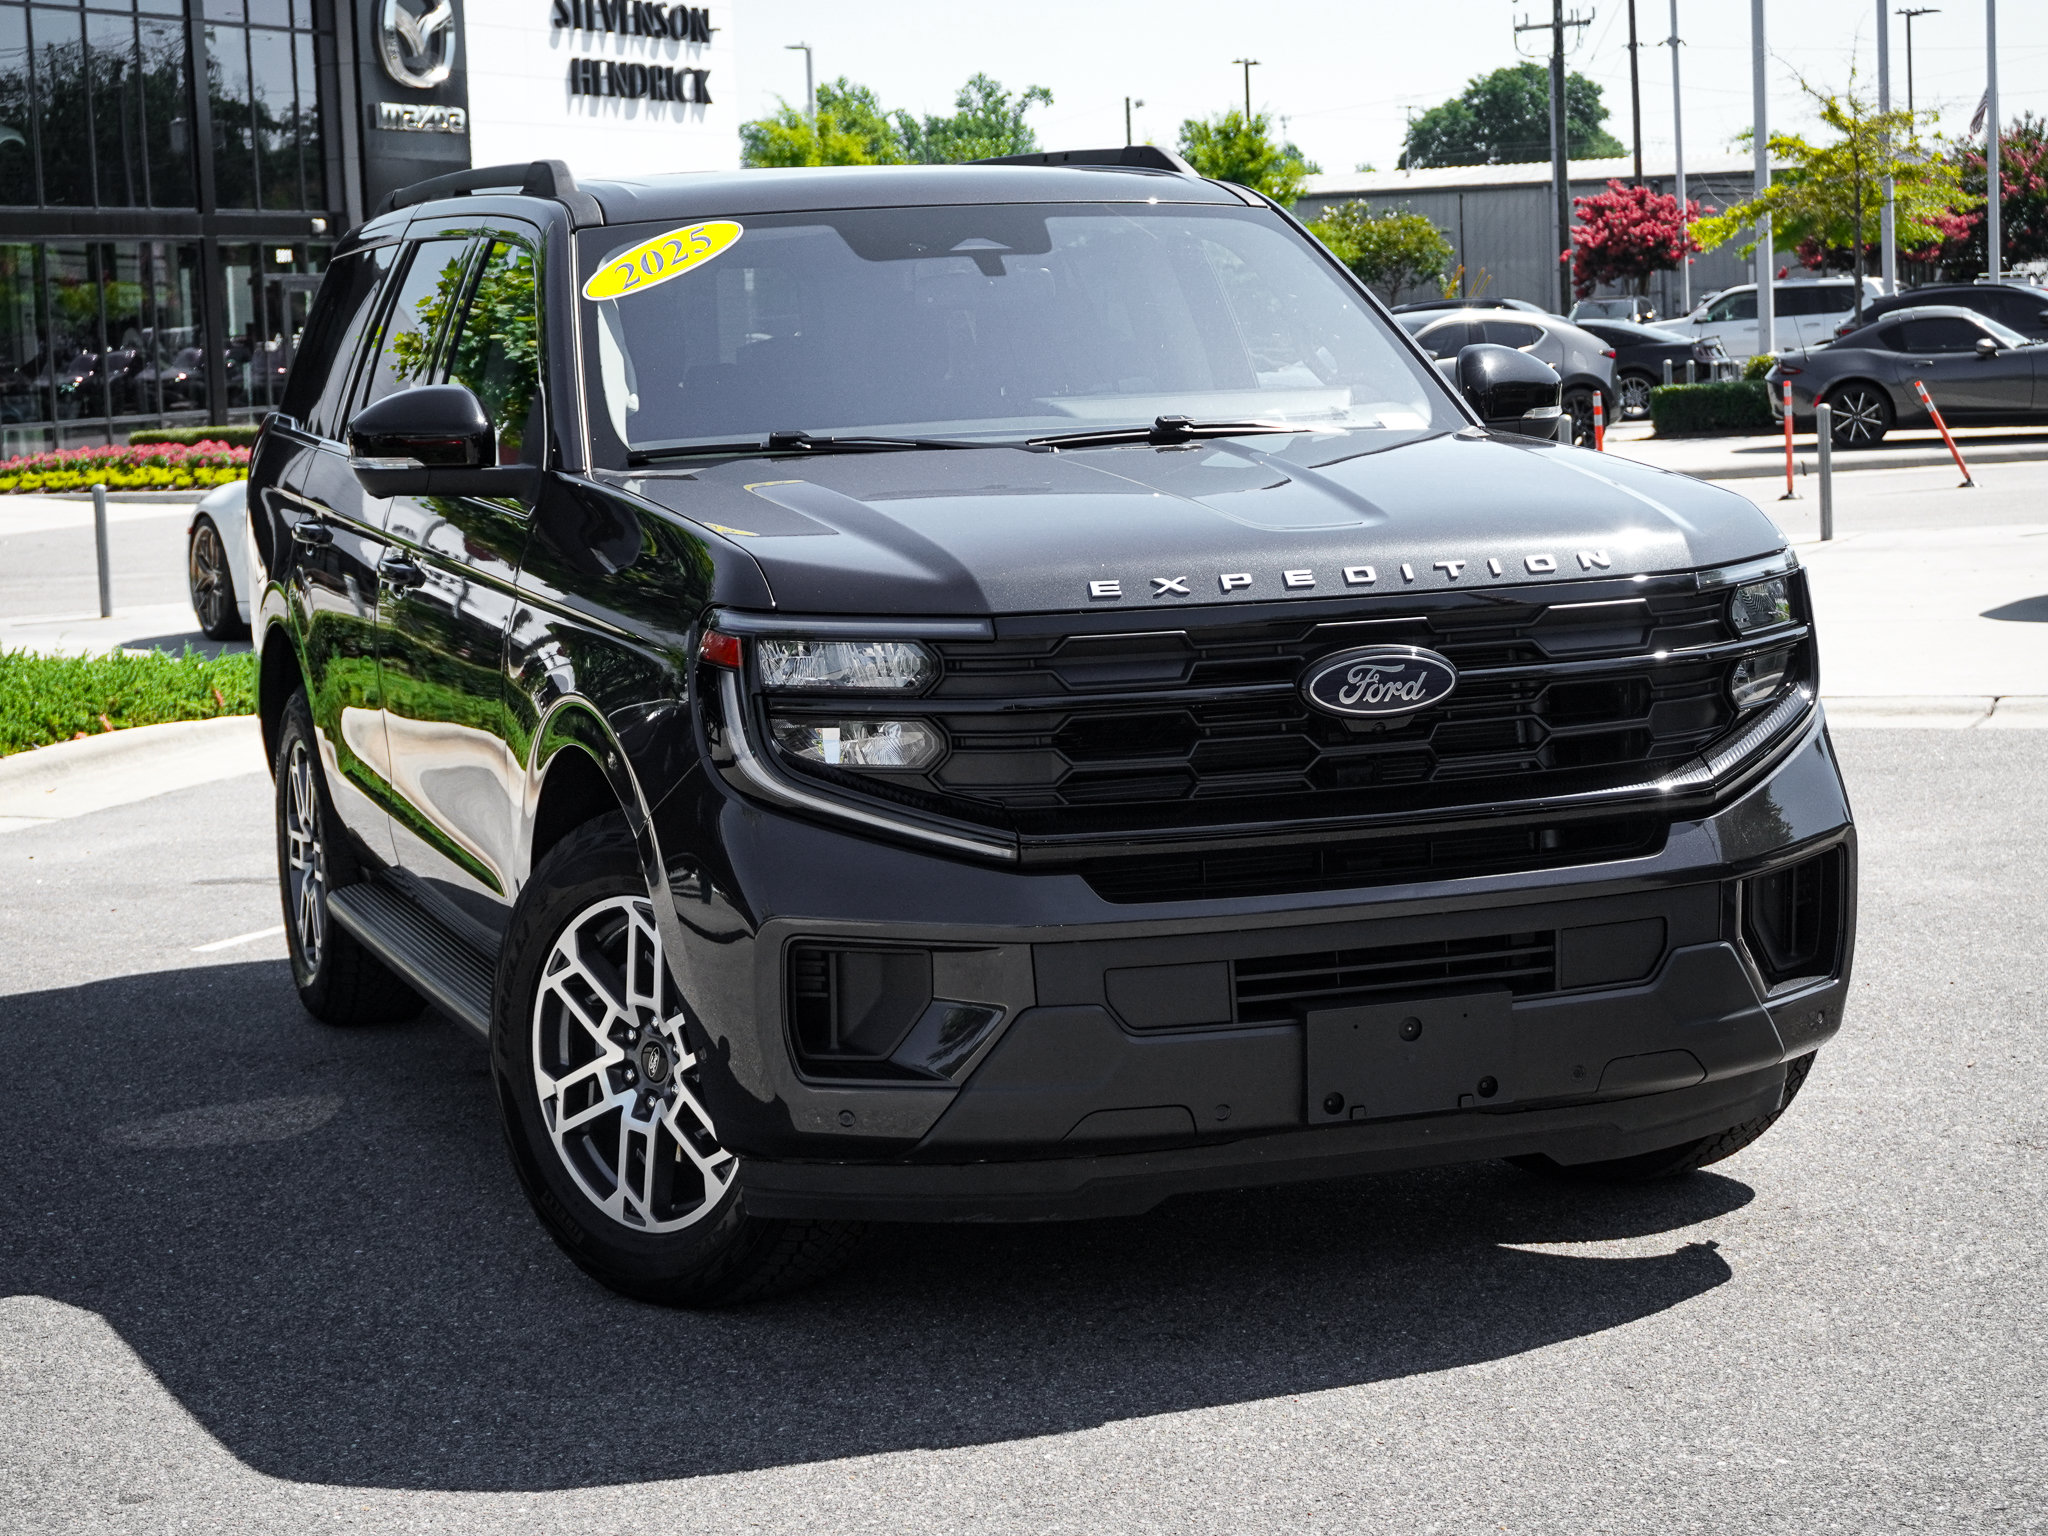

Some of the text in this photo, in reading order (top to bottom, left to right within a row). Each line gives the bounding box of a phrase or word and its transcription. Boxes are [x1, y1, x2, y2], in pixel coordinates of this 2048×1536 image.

[570, 58, 713, 104] HENDRICK
[379, 102, 466, 133] mazda
[614, 227, 712, 290] 2025
[1088, 549, 1612, 598] EXPEDITION
[1339, 664, 1428, 704] Ford
